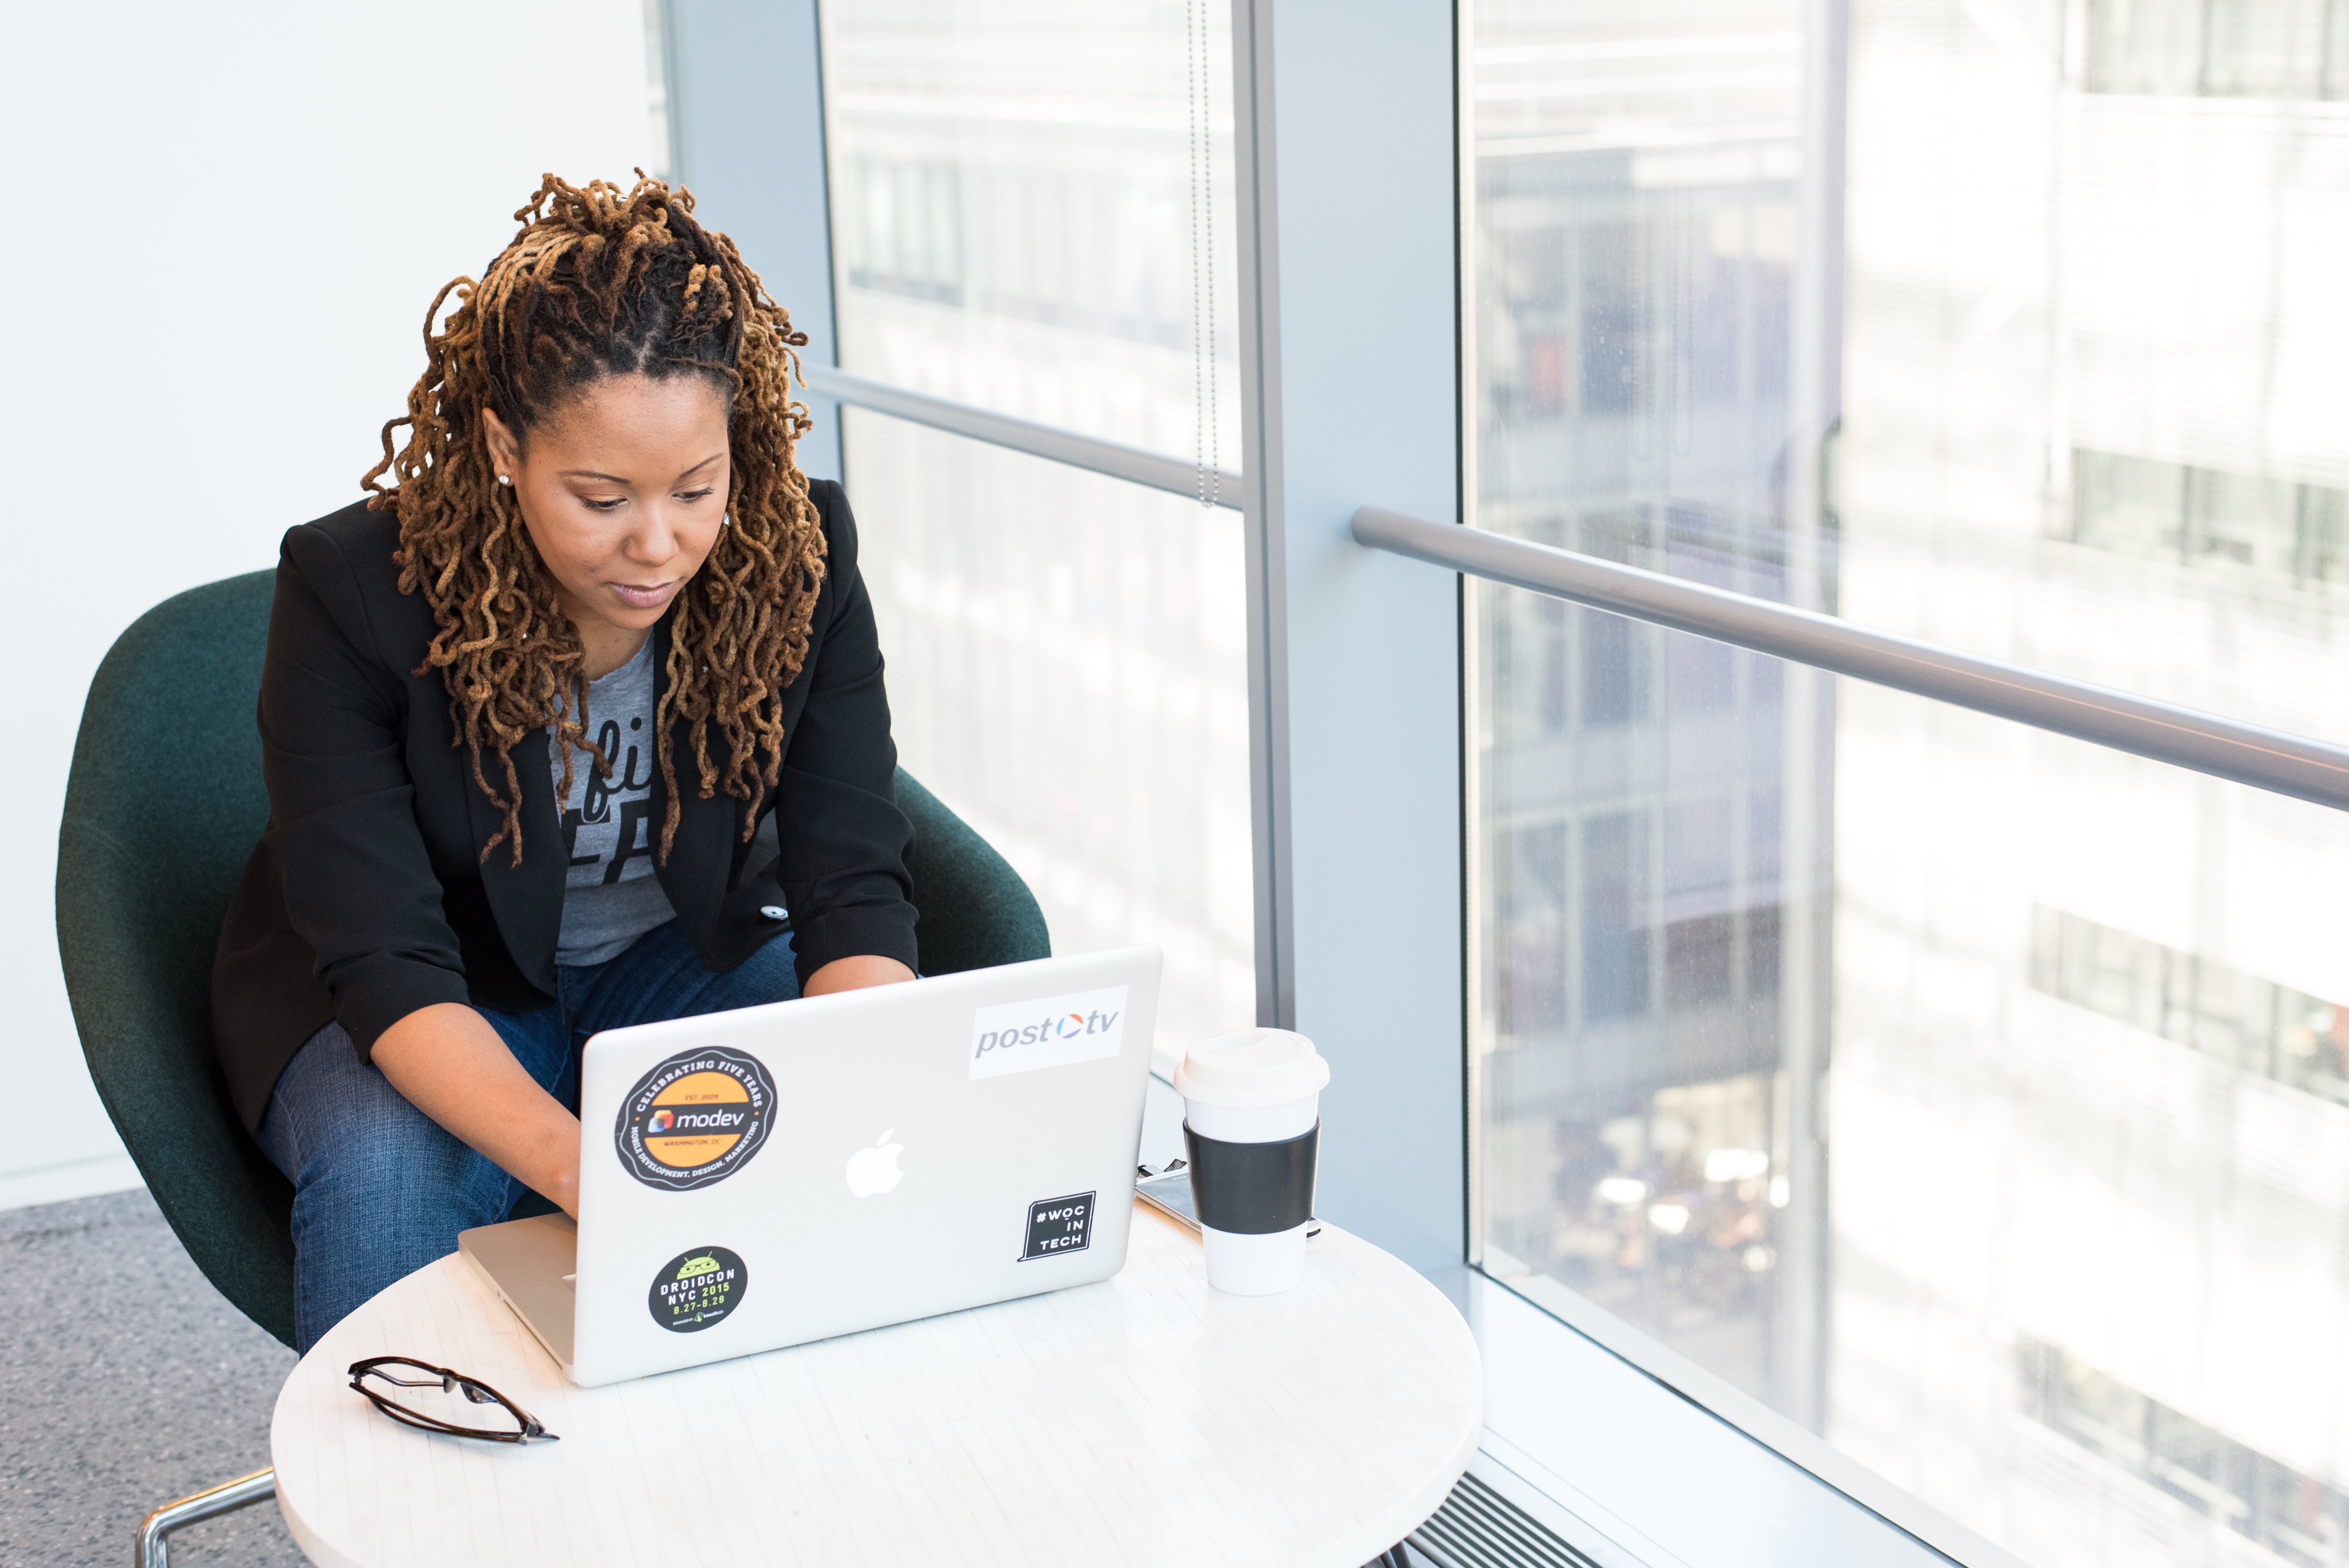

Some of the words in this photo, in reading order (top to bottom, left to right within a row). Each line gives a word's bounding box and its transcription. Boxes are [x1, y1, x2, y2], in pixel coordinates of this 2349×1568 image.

[975, 1018, 1053, 1059] post
[1087, 1010, 1119, 1034] tv
[637, 1060, 715, 1112] CELEBRATING
[720, 1061, 745, 1078] FIVE
[743, 1074, 763, 1107] YEARS
[677, 1109, 744, 1128] modev
[631, 1126, 641, 1154] MOBILE
[725, 1121, 759, 1162] MARKETING
[1036, 1205, 1085, 1223] #WOC
[1067, 1219, 1083, 1231] IN
[1040, 1234, 1081, 1250] TECH
[661, 1269, 734, 1295] DROIDCON
[668, 1290, 696, 1305] NYC
[702, 1282, 729, 1297] 2015
[674, 1295, 724, 1314] 8.27-8.28
